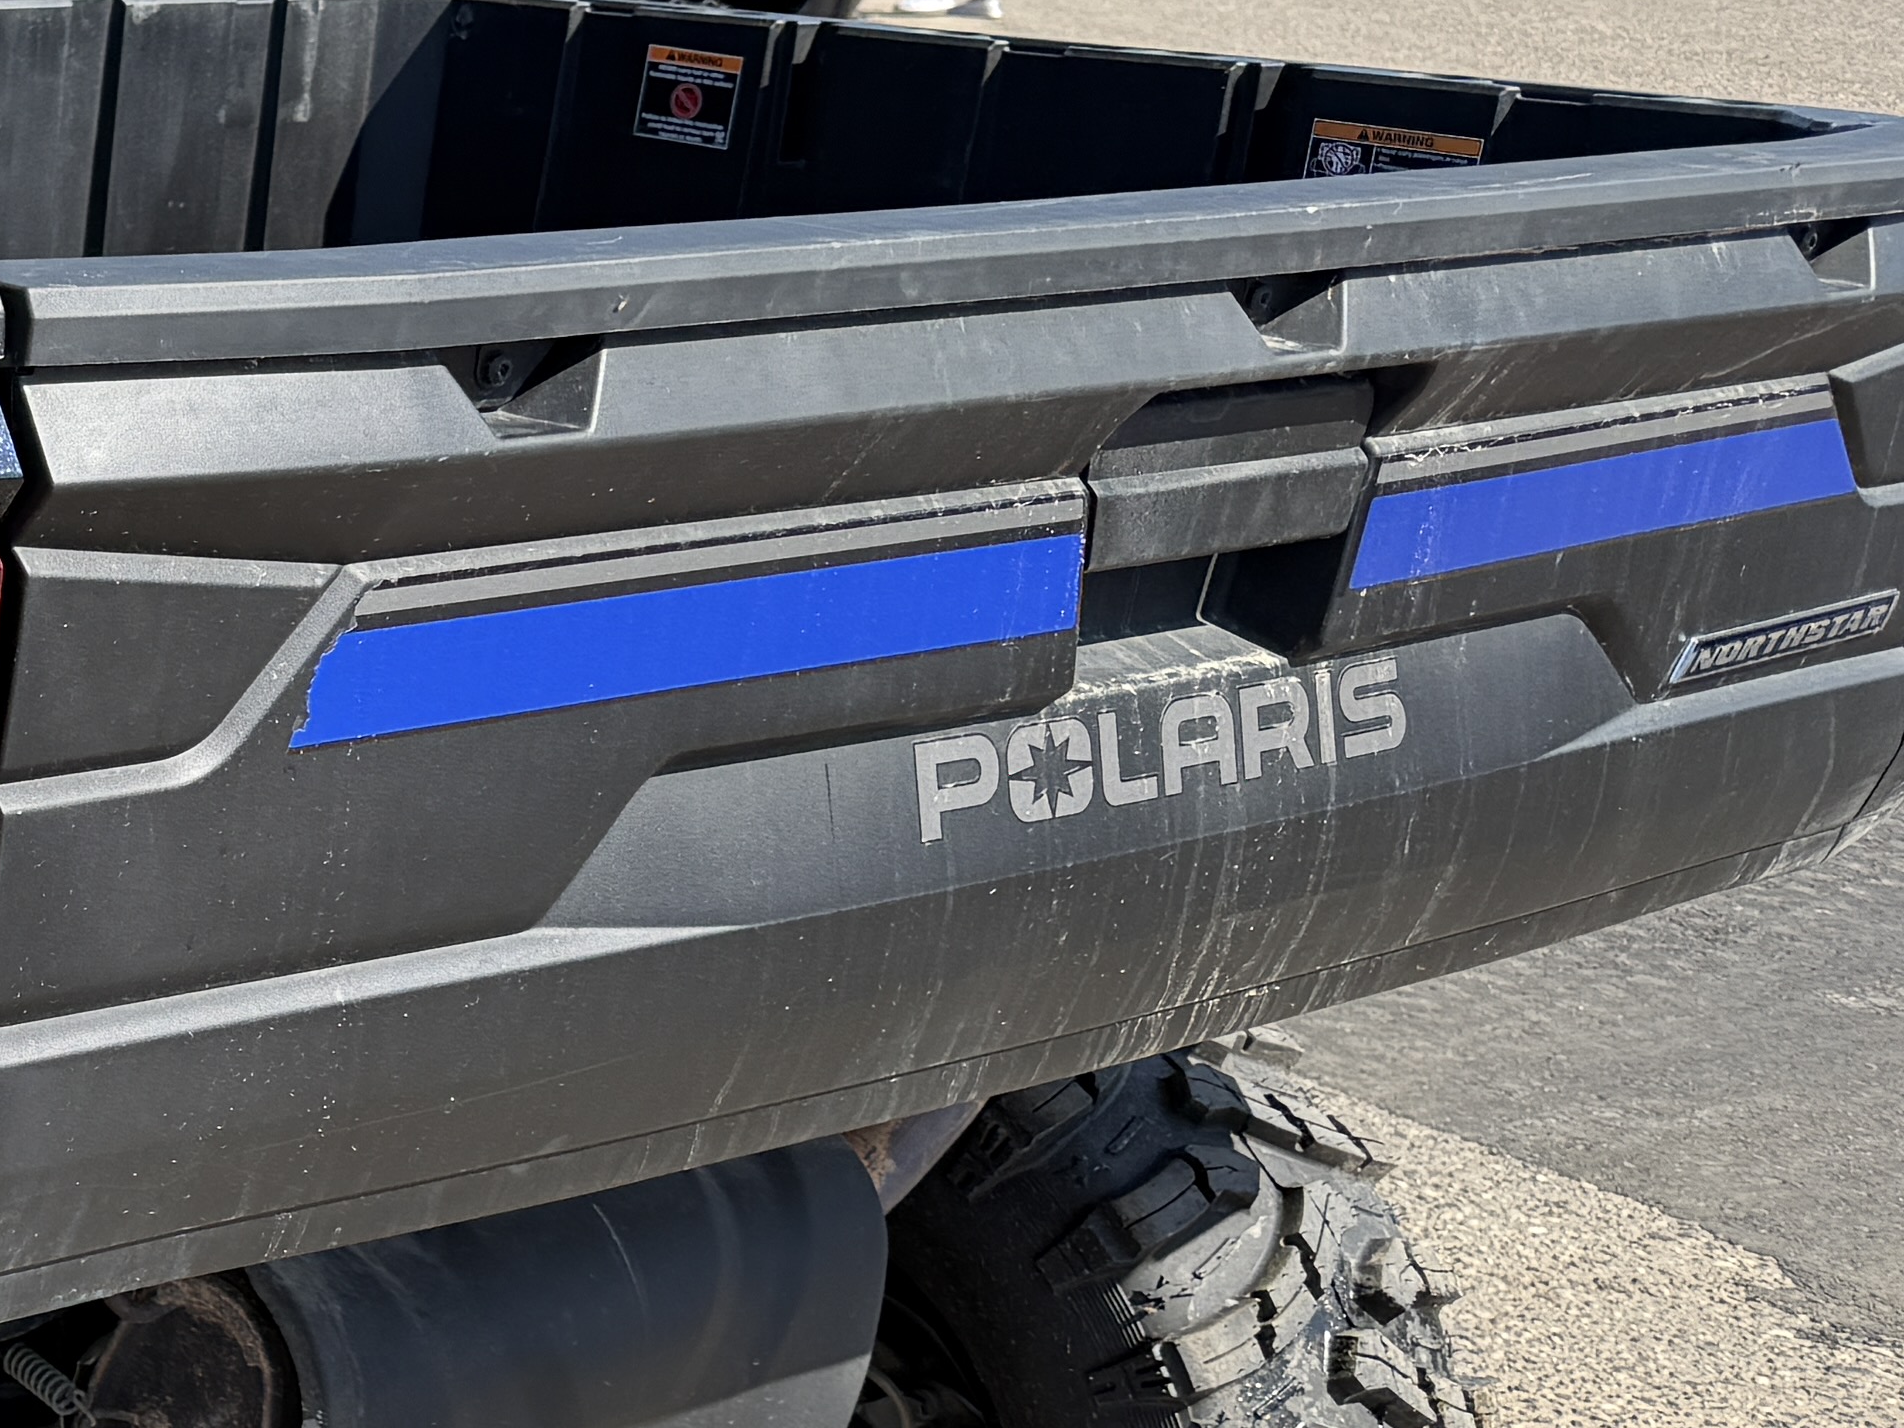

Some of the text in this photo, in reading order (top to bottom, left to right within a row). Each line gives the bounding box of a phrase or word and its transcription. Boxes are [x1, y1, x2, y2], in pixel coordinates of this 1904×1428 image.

[678, 51, 724, 68] WARNING
[1372, 130, 1424, 148] WARNING
[1690, 603, 1891, 671] NORTHSTAR
[913, 657, 1407, 844] POLARIS
